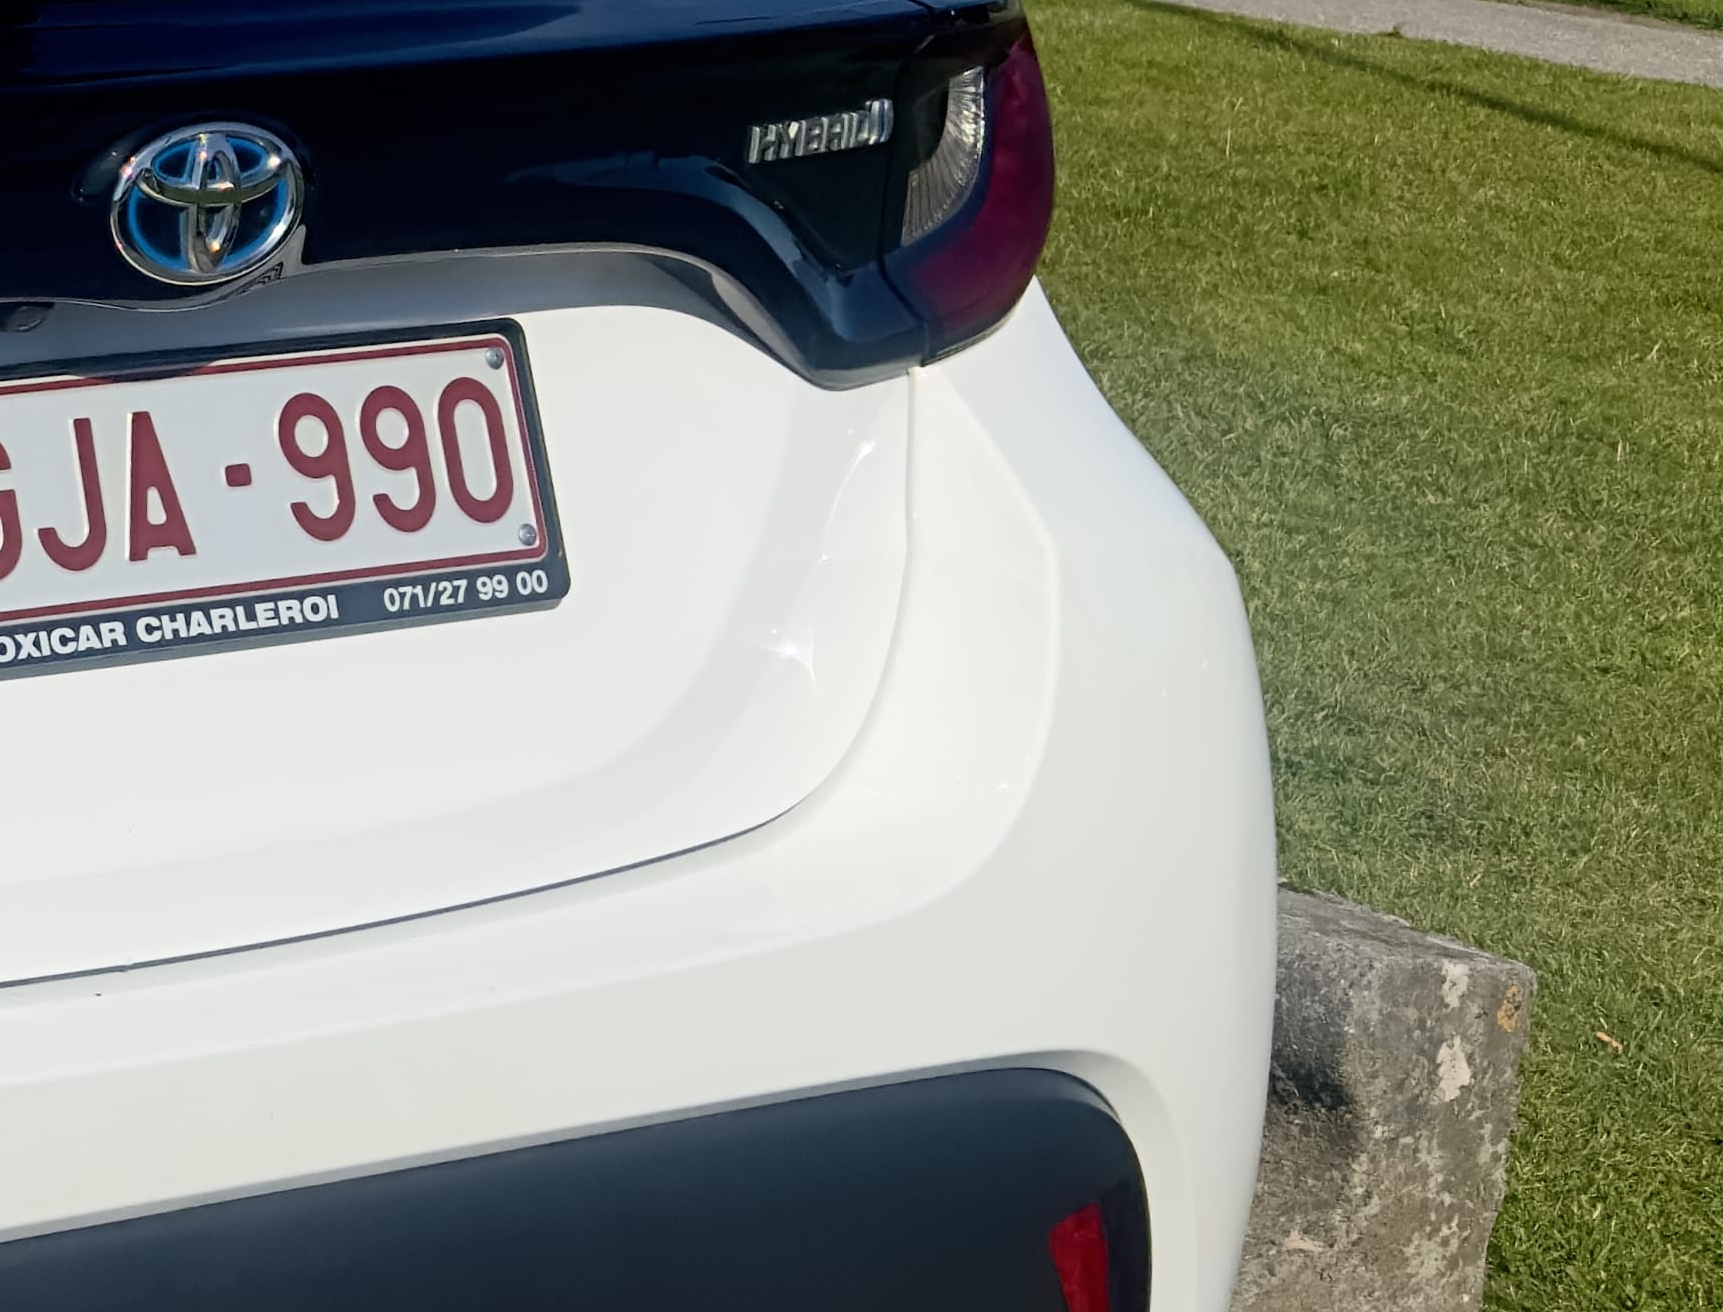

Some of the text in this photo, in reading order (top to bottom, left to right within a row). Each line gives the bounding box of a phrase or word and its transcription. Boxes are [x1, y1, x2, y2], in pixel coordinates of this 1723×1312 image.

[383, 570, 548, 612] 071/27 99 00
[136, 595, 339, 644] CHARLEROI
